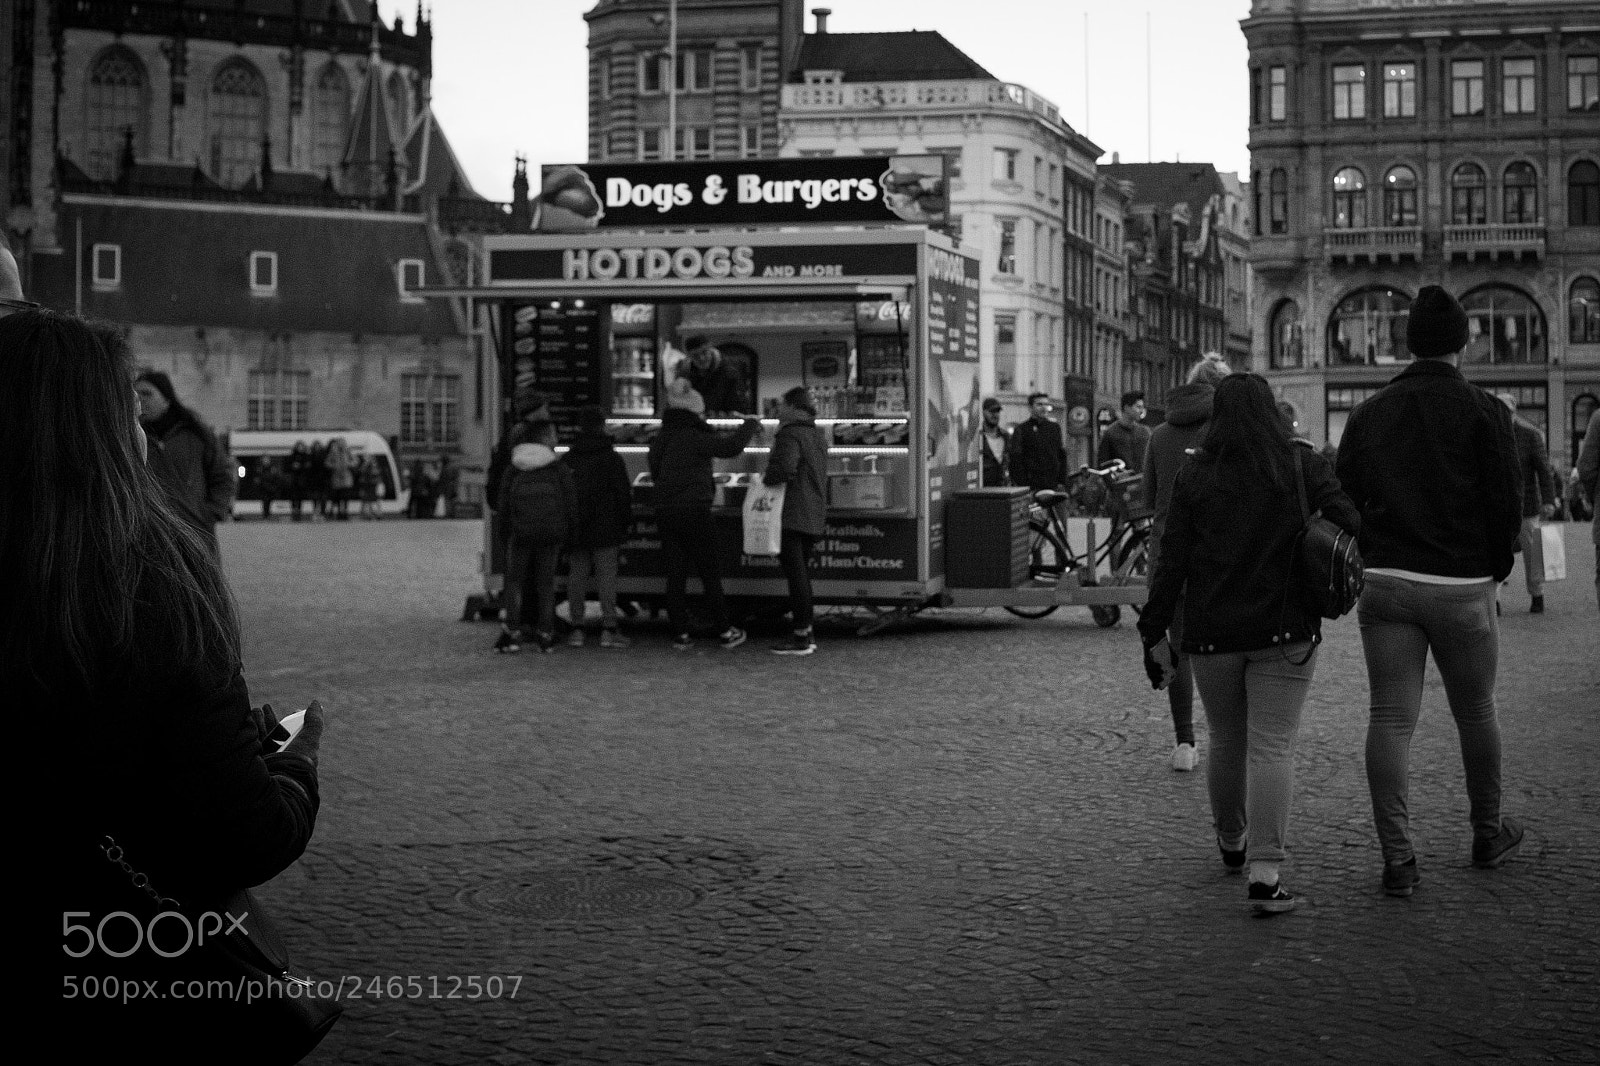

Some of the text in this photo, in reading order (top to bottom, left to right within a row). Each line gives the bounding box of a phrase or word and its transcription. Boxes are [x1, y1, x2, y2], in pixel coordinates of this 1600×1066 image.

[606, 174, 877, 213] Dogs & Burgers
[563, 246, 843, 280] HOTDOGS AND MORE
